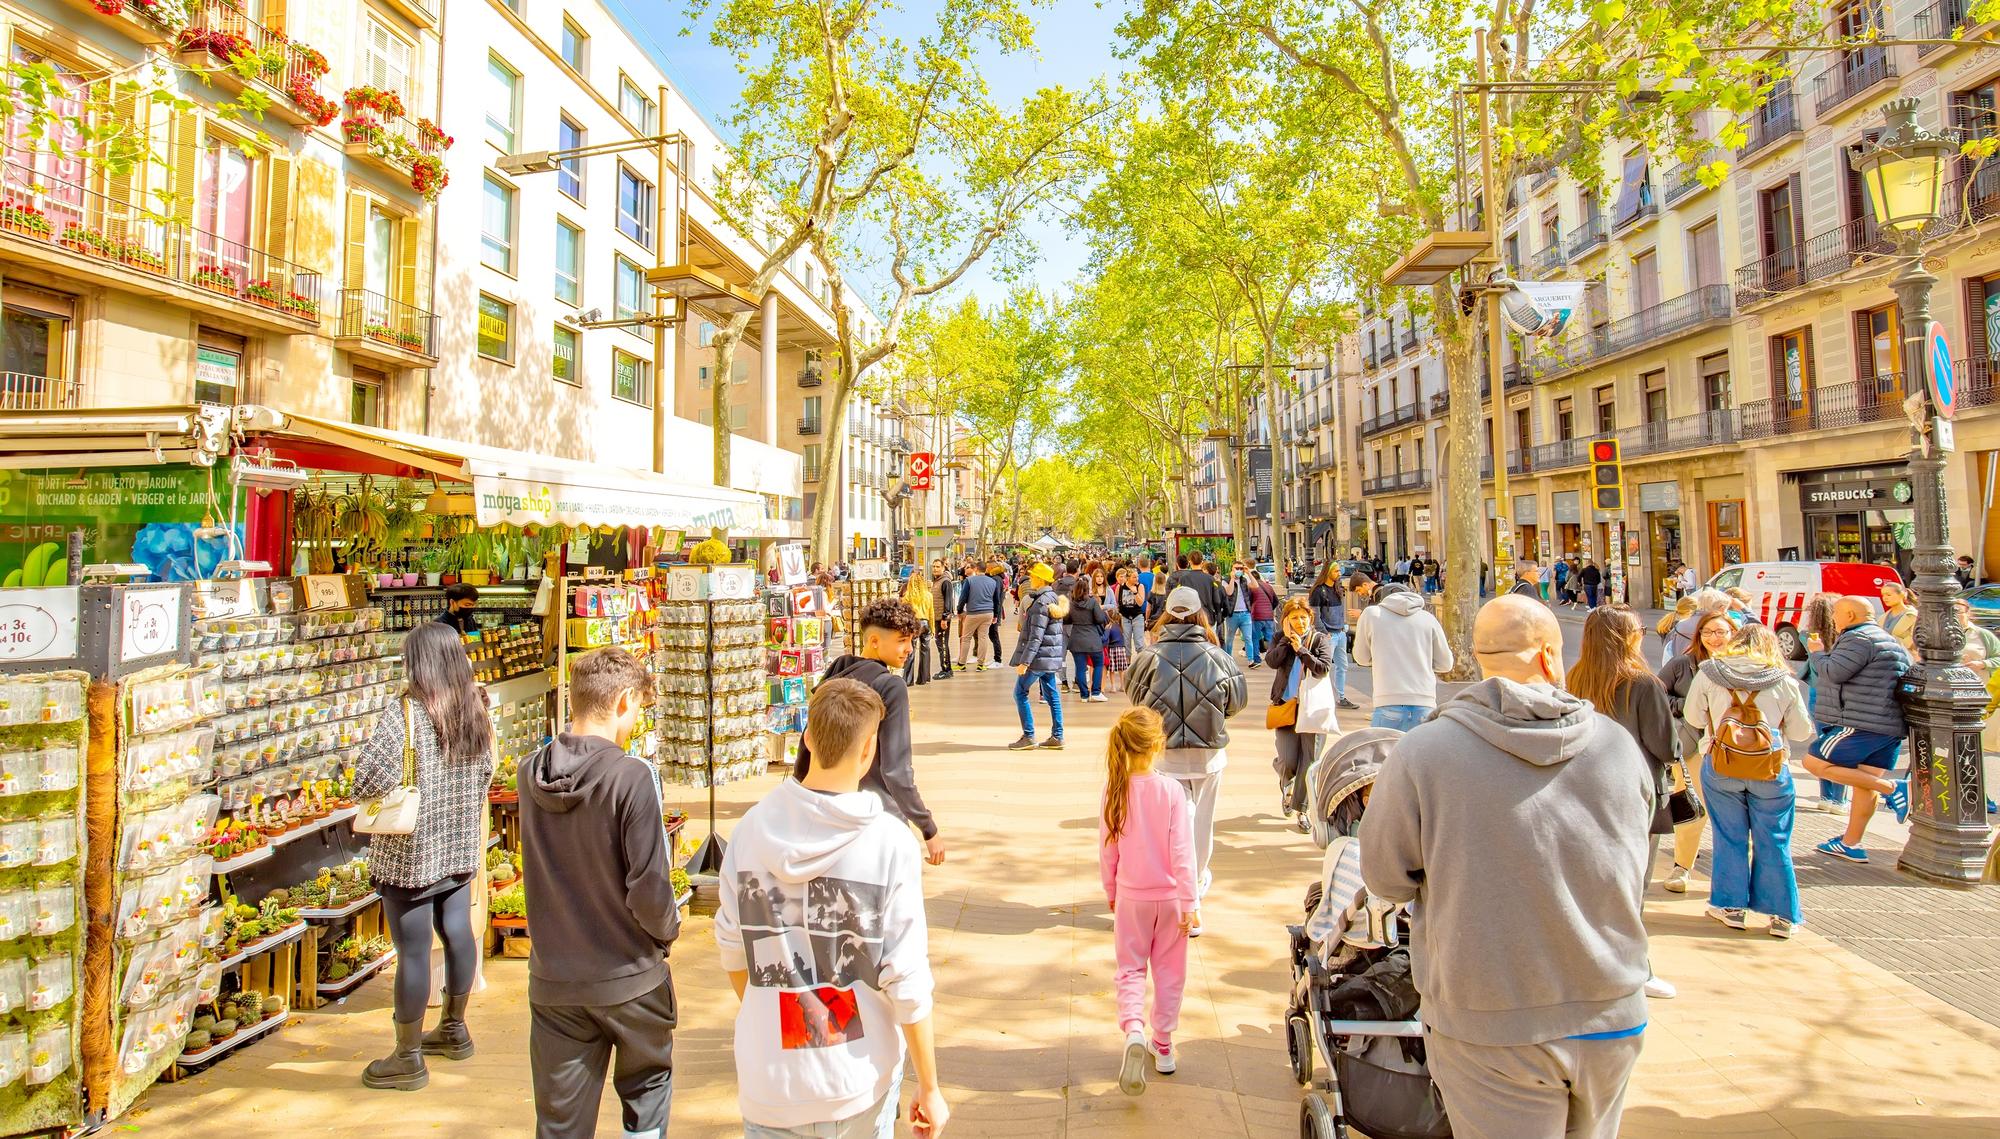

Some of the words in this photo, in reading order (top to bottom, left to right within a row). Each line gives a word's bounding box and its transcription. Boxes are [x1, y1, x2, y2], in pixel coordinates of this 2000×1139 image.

[915, 461, 923, 470] M
[102, 478, 135, 489] HUERTO
[36, 493, 76, 505] ORCHARD
[78, 493, 84, 505] &
[87, 493, 121, 505] GARDEN
[132, 493, 164, 505] VERGER
[167, 494, 176, 505] et
[178, 493, 187, 505] le
[1811, 489, 1875, 502] STARBUCKS
[13, 619, 26, 630] 3€
[11, 632, 31, 643] 10€
